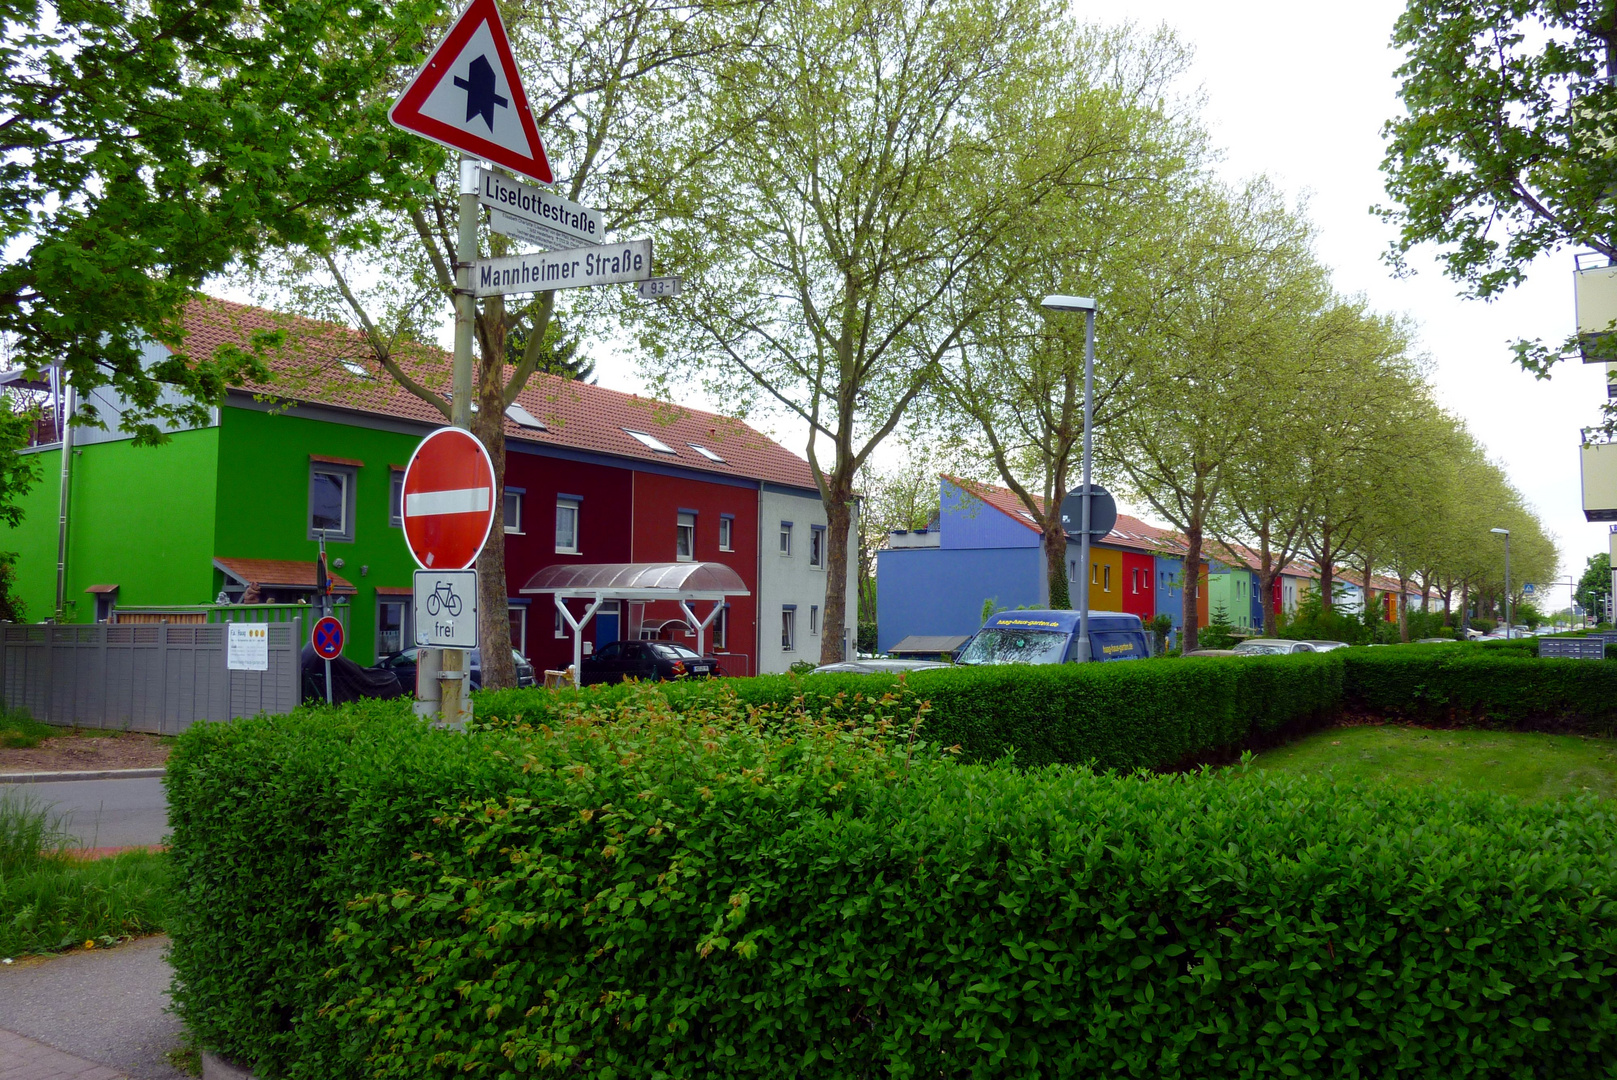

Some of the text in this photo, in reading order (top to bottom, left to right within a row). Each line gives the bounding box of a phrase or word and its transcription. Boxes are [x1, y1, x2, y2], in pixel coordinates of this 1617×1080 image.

[486, 176, 596, 235] Liselottestraße
[480, 250, 642, 288] Mannheimer Straße
[651, 280, 676, 294] 93-1
[435, 622, 454, 637] frei
